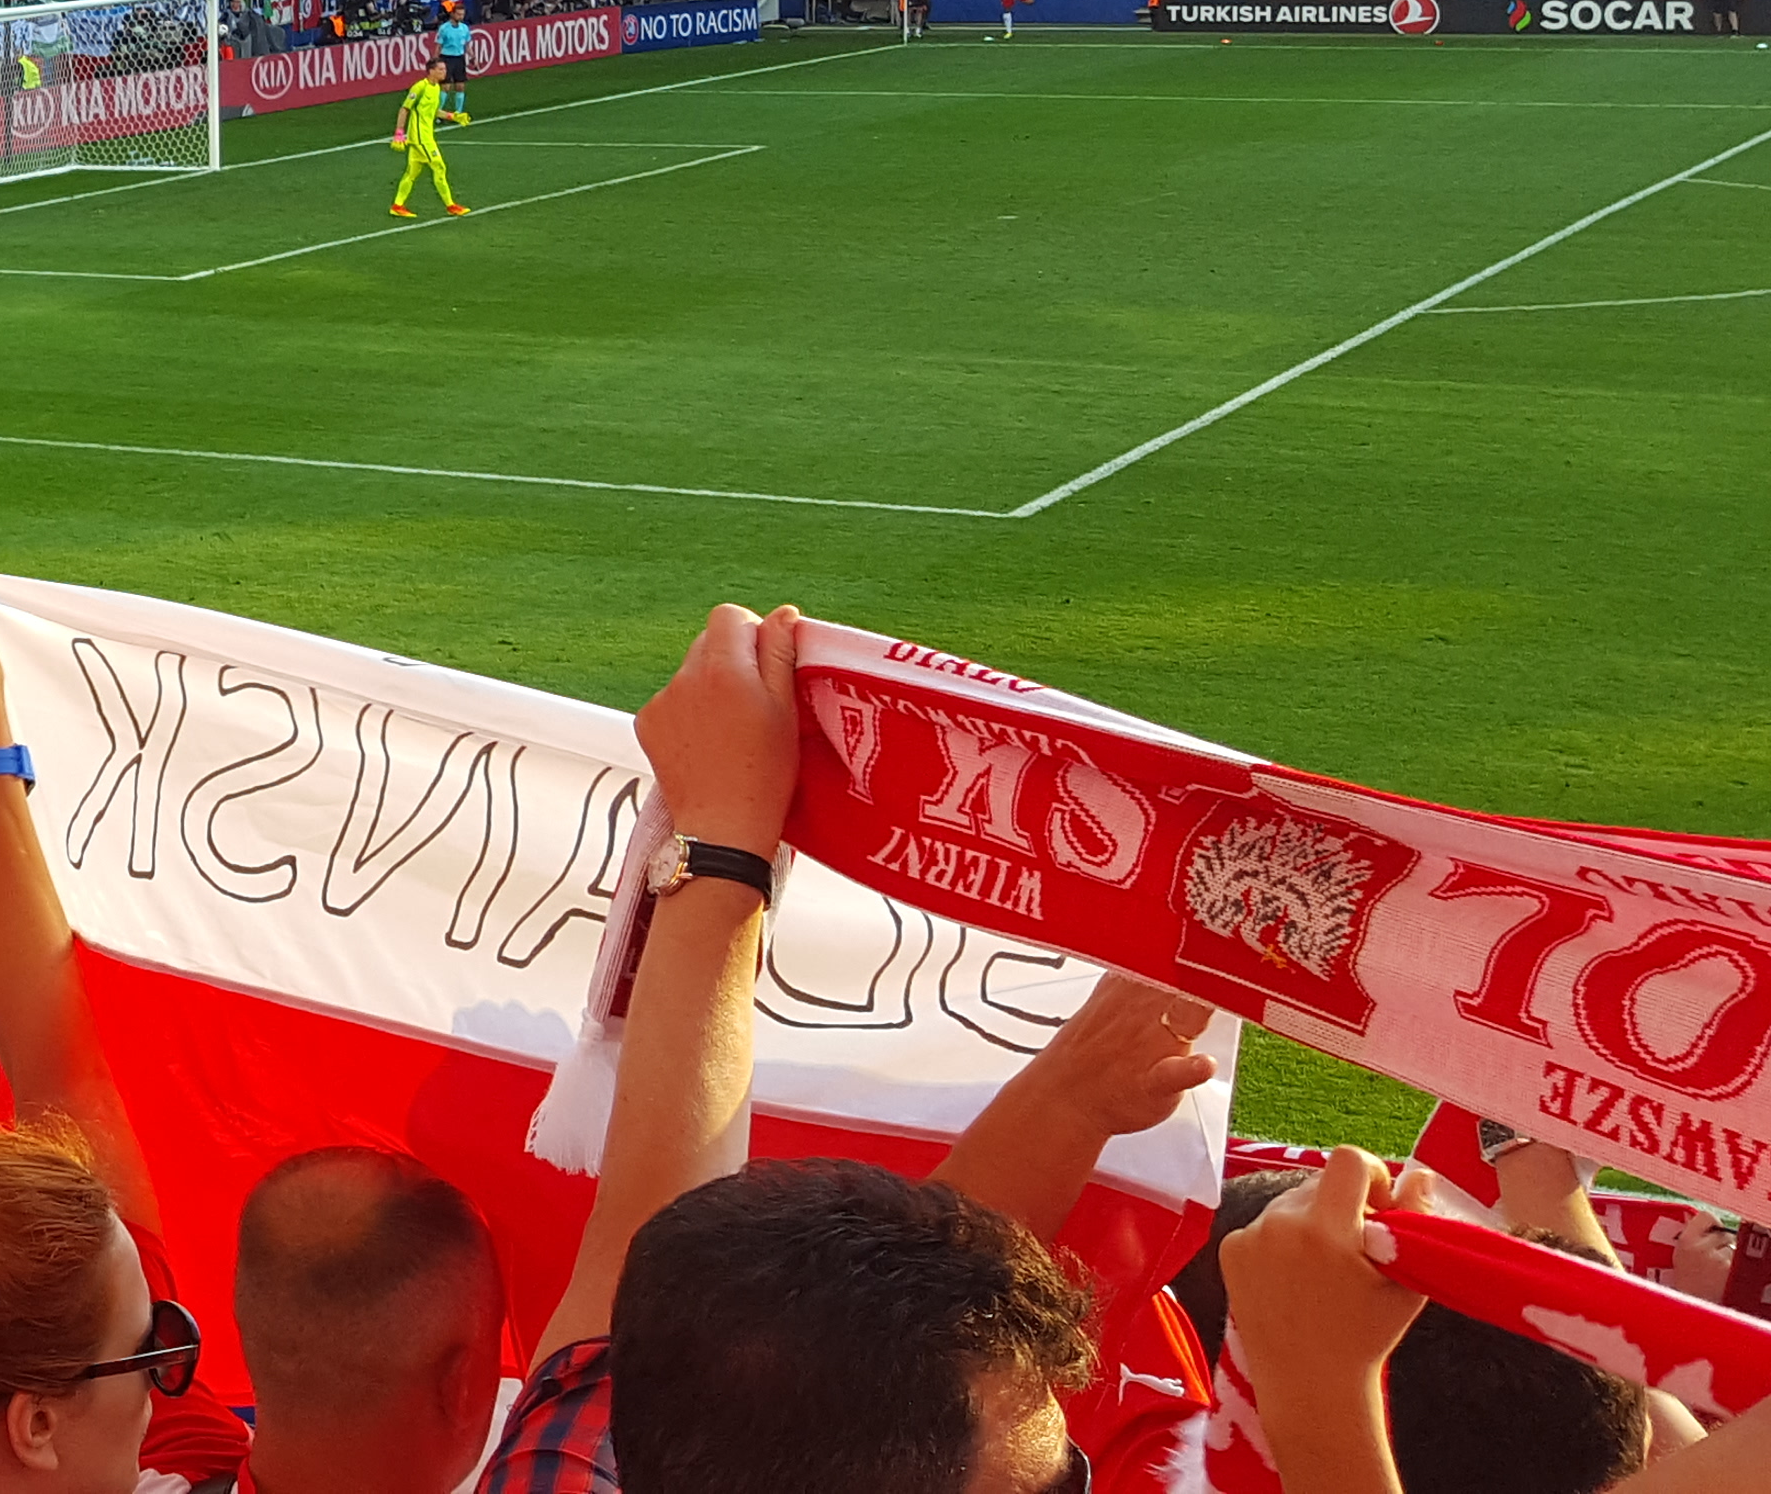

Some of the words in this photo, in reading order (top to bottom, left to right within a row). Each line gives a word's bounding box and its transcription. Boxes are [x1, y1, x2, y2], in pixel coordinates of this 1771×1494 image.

[640, 15, 668, 40] NO
[669, 12, 693, 37] TO
[695, 7, 758, 35] RACISM
[1166, 4, 1272, 24] TURKISH
[1275, 4, 1388, 24] AIRLINES
[1539, 0, 1695, 32] SOCAR
[497, 34, 522, 64] KIA
[527, 14, 611, 59] MOTORS
[299, 50, 335, 85] KIA
[343, 32, 429, 80] MOTORS
[114, 66, 206, 119] MOTOR
[259, 62, 290, 90] KIA
